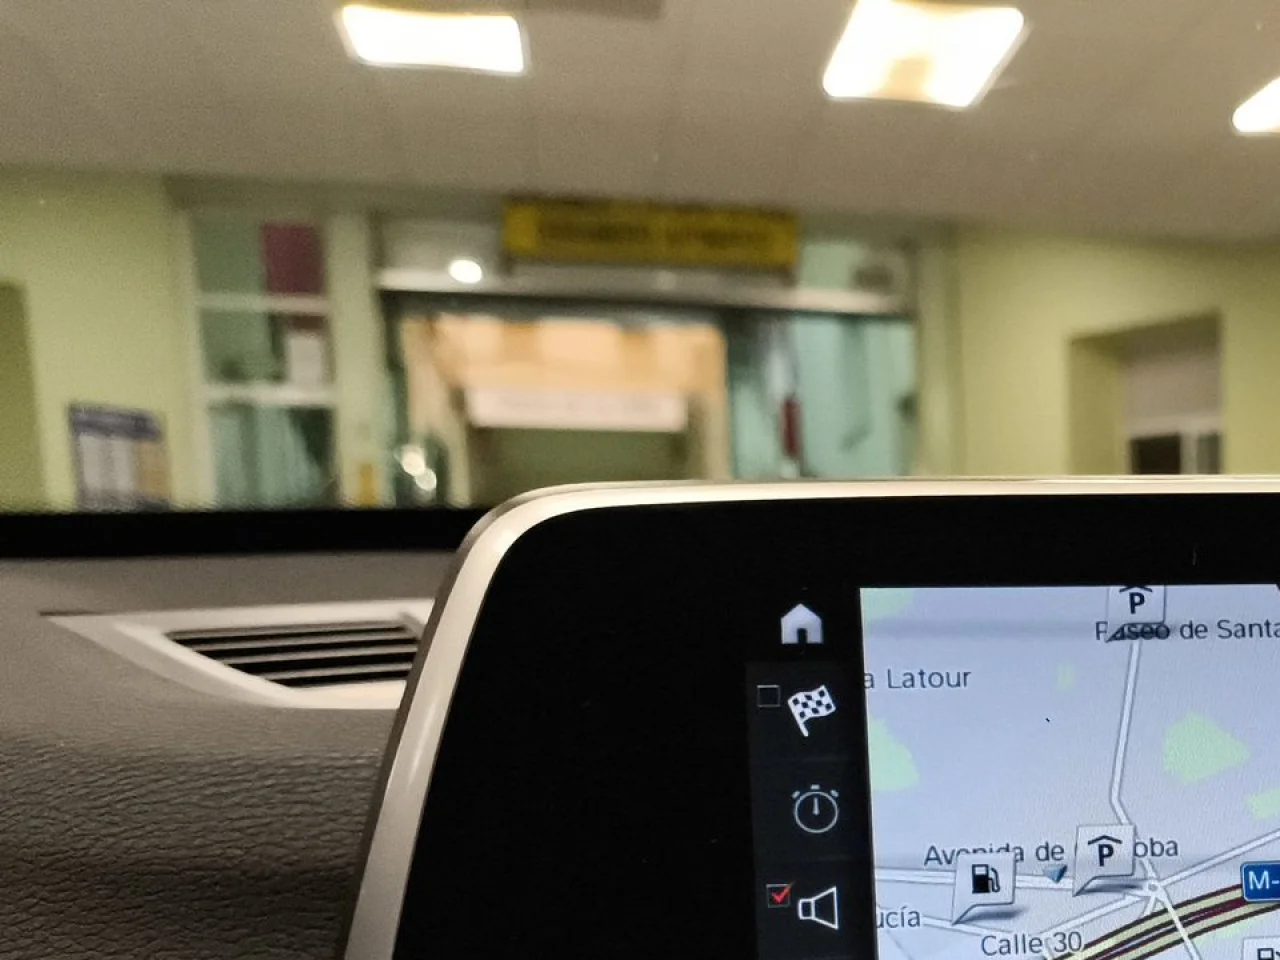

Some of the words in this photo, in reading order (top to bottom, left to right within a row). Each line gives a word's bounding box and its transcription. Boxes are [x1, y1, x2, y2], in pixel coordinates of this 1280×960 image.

[1179, 619, 1208, 639] de
[887, 668, 972, 689] Latour
[1035, 841, 1065, 862] de
[981, 933, 1043, 957] Calle
[1052, 931, 1083, 953] 30
